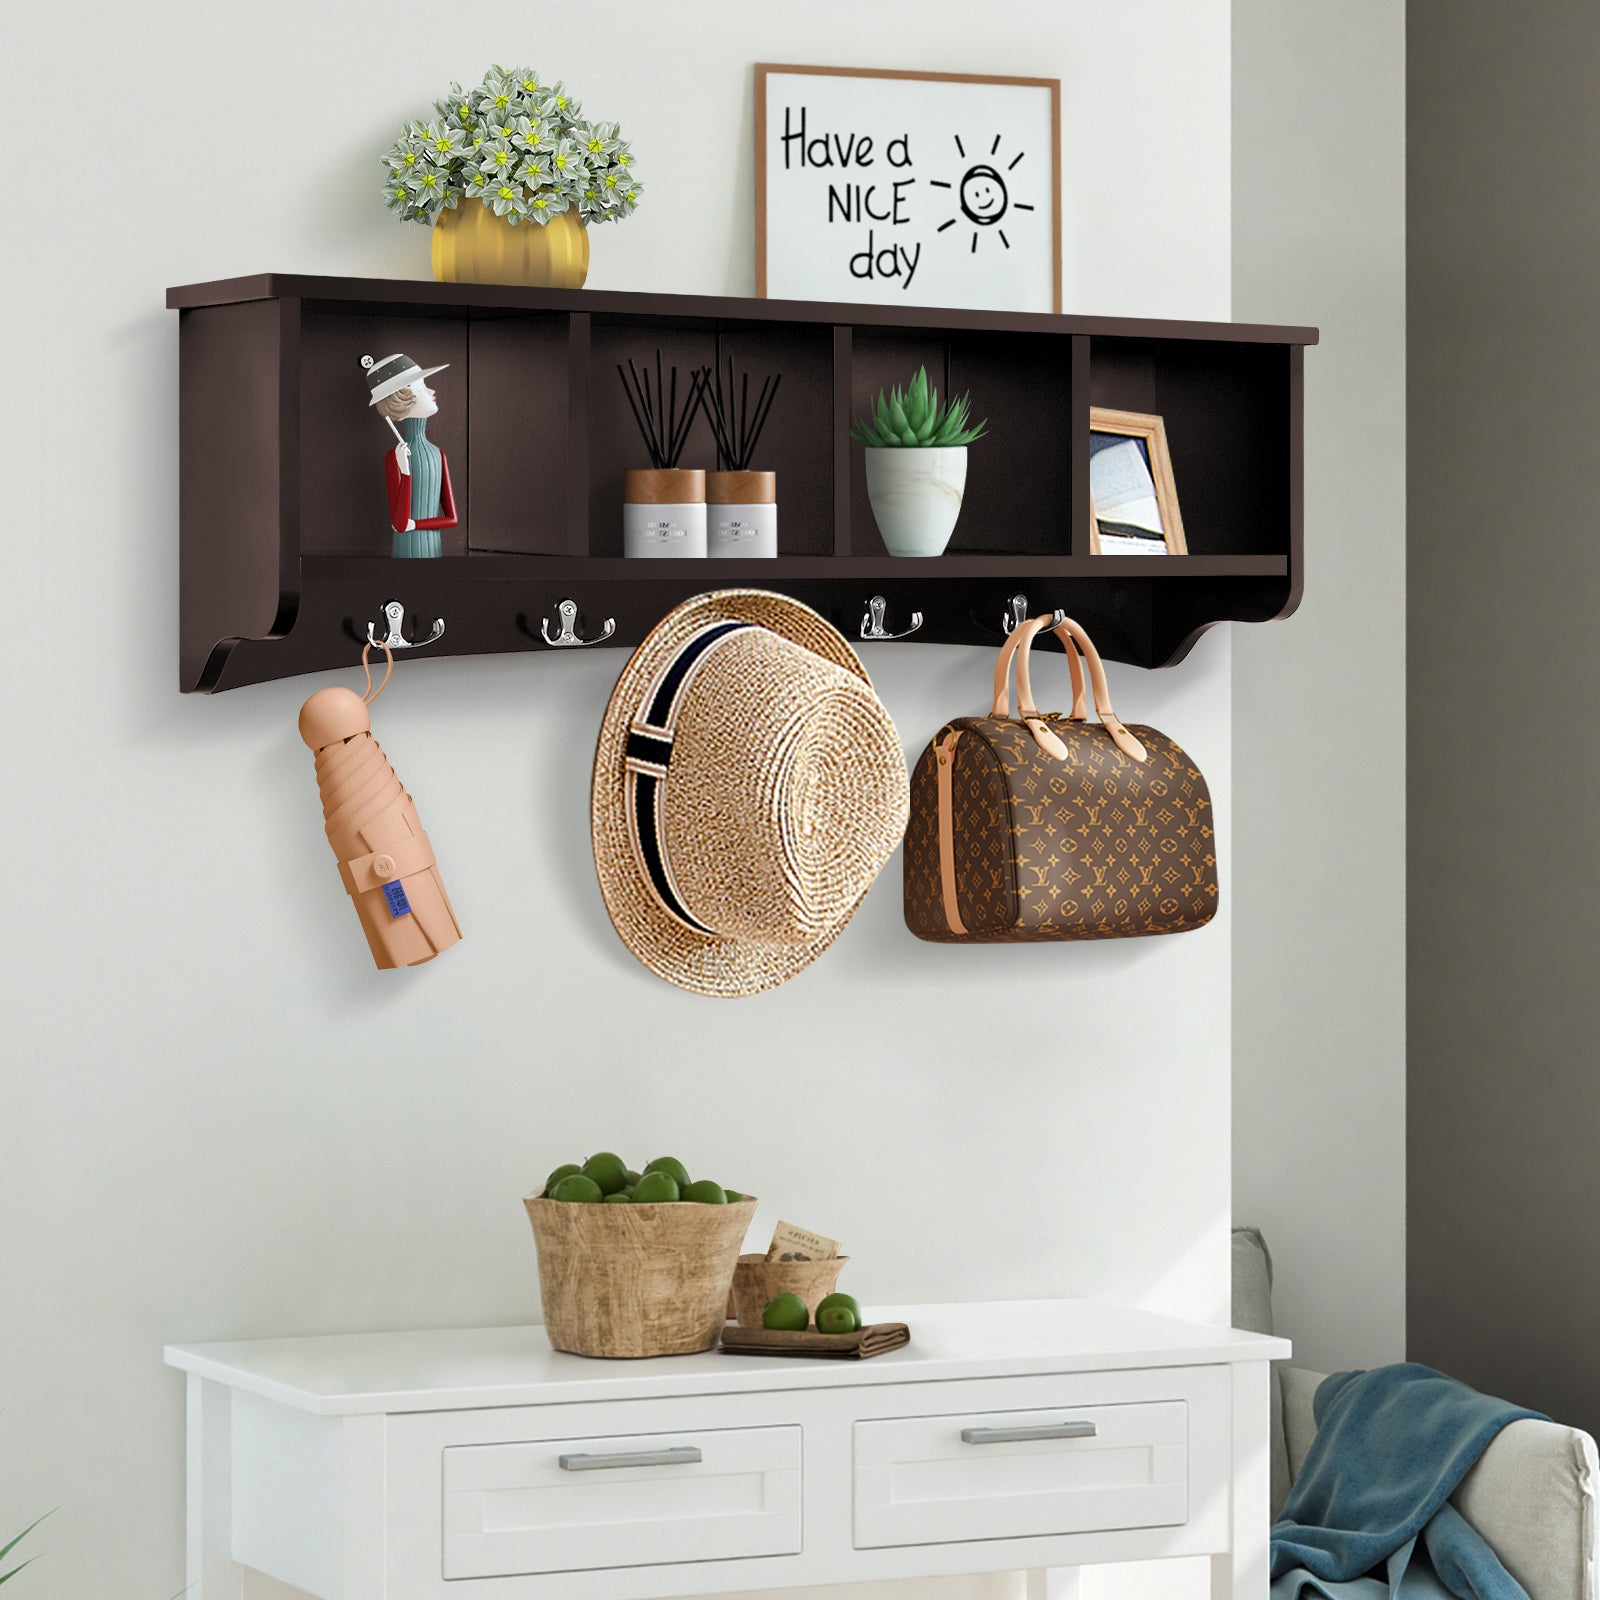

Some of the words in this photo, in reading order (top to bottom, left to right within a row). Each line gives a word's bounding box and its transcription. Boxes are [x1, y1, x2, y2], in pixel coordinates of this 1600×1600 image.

[781, 106, 874, 169] Have
[887, 133, 912, 167] a
[829, 178, 916, 225] NICE
[850, 229, 921, 290] day
[1023, 805, 1045, 825] LV
[1085, 806, 1102, 825] LV
[1132, 807, 1149, 825] LV
[1185, 808, 1200, 826] LV
[1028, 866, 1050, 886] LV
[1092, 866, 1108, 886] LV
[1139, 866, 1154, 886] LV
[1191, 866, 1205, 885] LV
